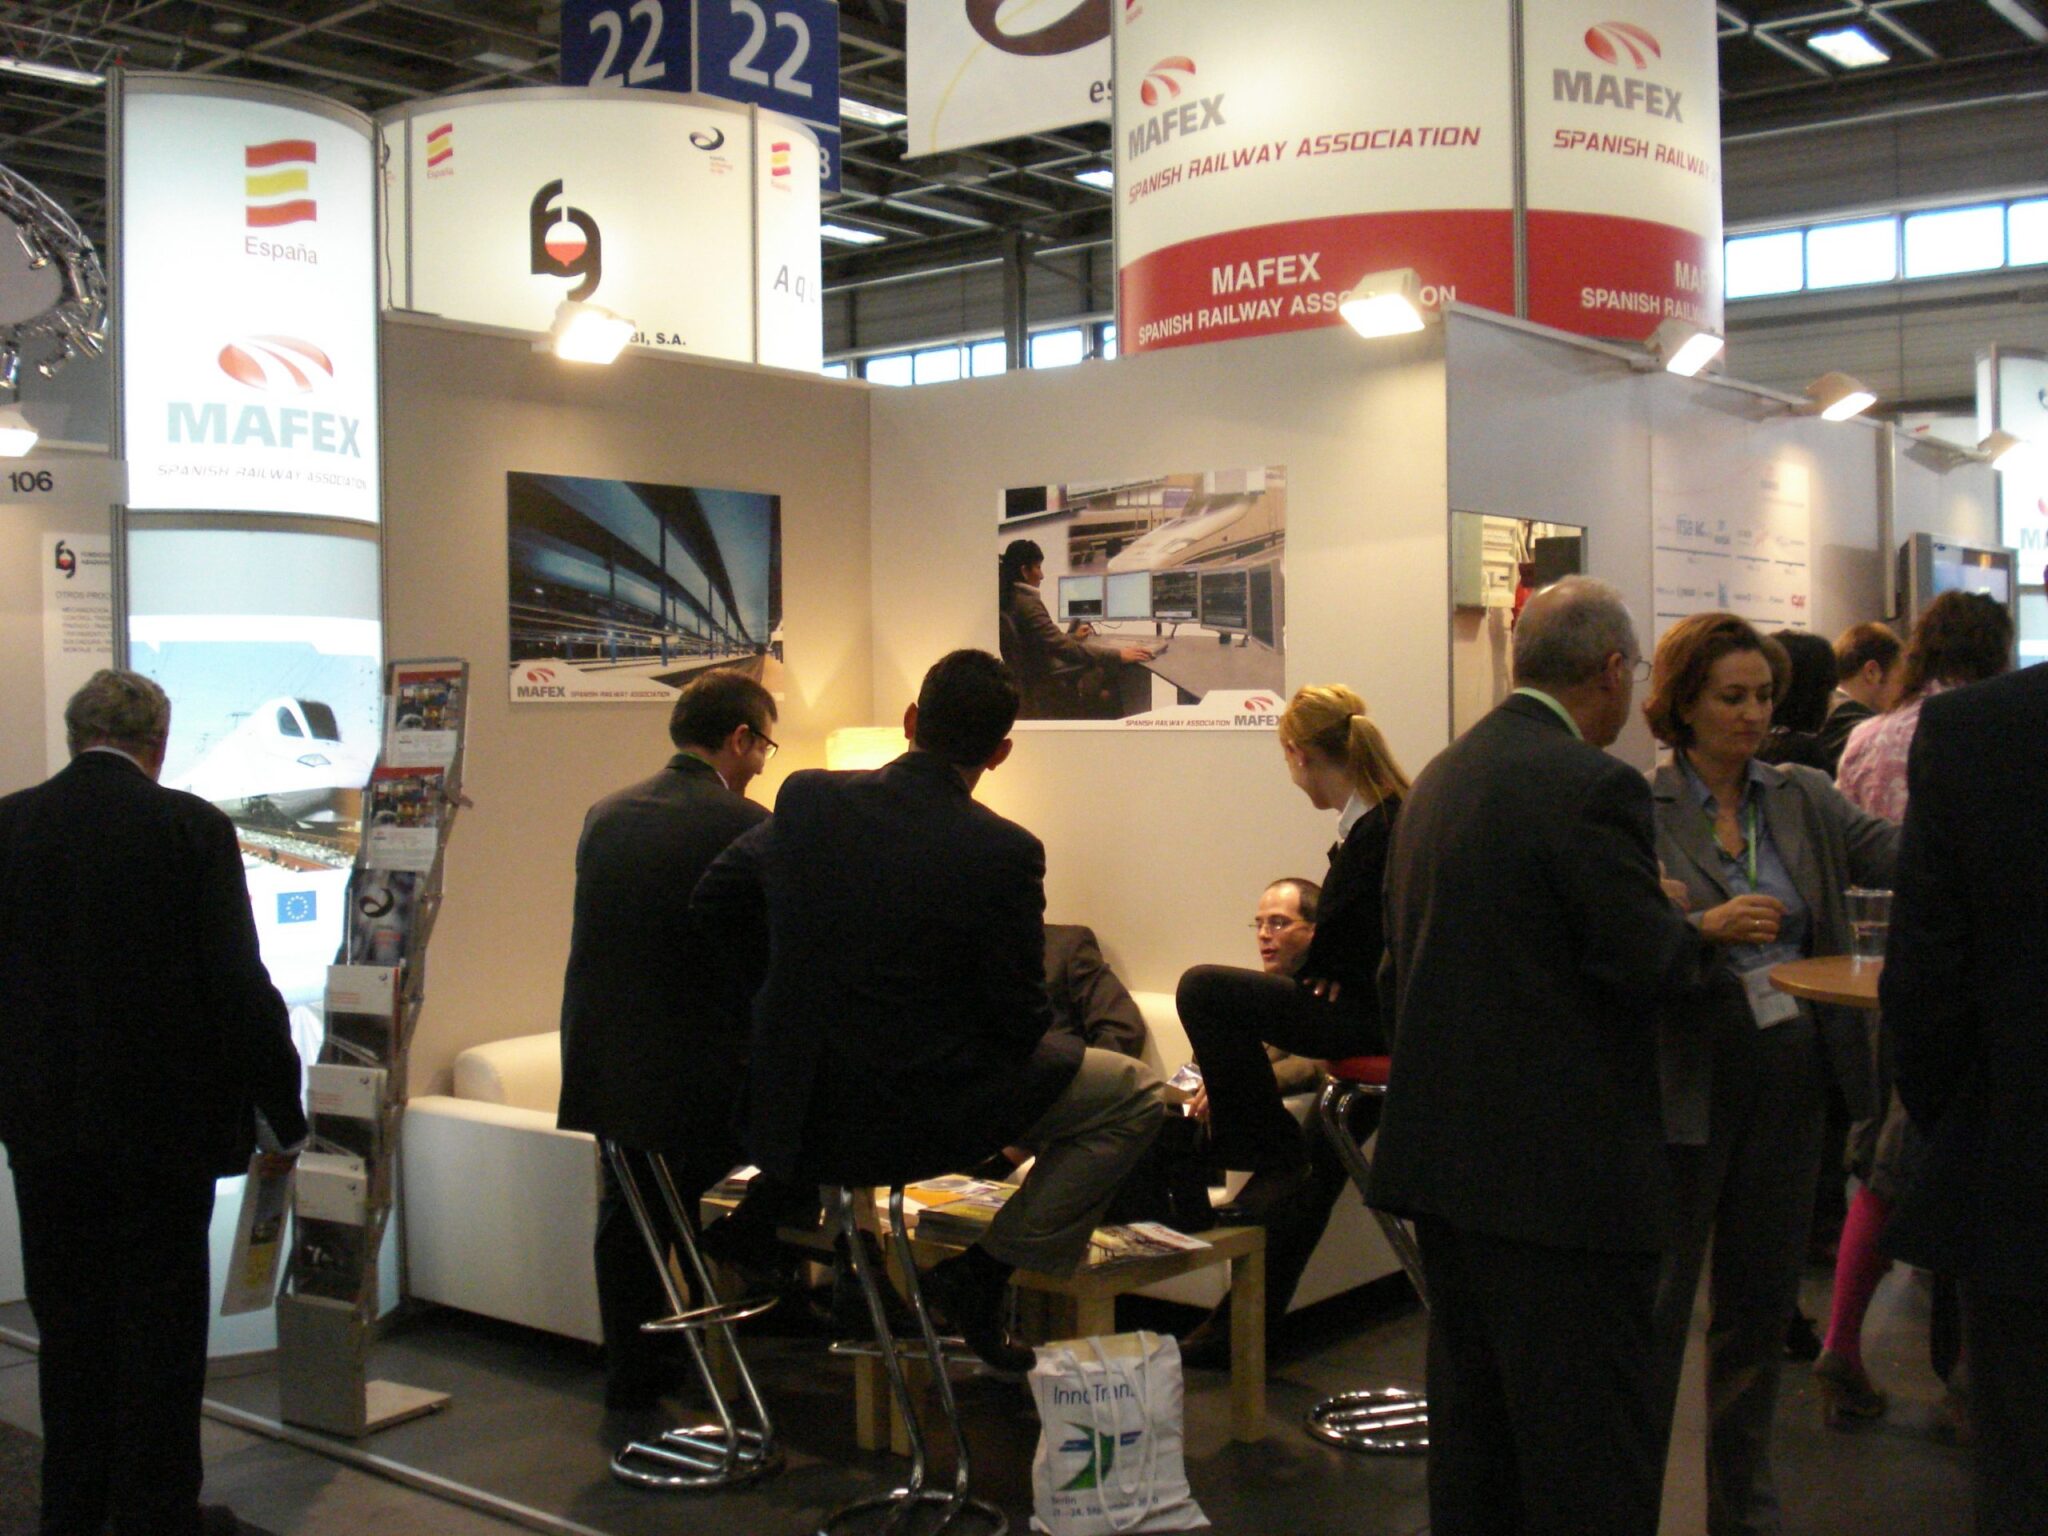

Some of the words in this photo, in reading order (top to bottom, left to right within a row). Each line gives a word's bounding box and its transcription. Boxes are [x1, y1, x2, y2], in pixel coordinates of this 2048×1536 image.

[588, 0, 665, 88] 22
[729, 0, 812, 97] 22
[1553, 68, 1683, 123] MAFEX
[1128, 94, 1226, 160] MAFEX
[1553, 129, 1649, 158] SPANISH
[1129, 164, 1183, 204] SPANISH
[1188, 140, 1288, 179] RAILWAY
[1296, 127, 1481, 157] ASSOCIATION
[245, 236, 318, 264] España
[1212, 252, 1321, 295] MAFEX
[1138, 315, 1193, 345] SPANISH
[1198, 297, 1284, 329] RAILWAY
[1581, 287, 1660, 315] SPANISH
[655, 332, 686, 346] S.A.
[167, 402, 361, 458] MAFEX
[8, 471, 53, 492] 106
[517, 686, 565, 698] MAFEX
